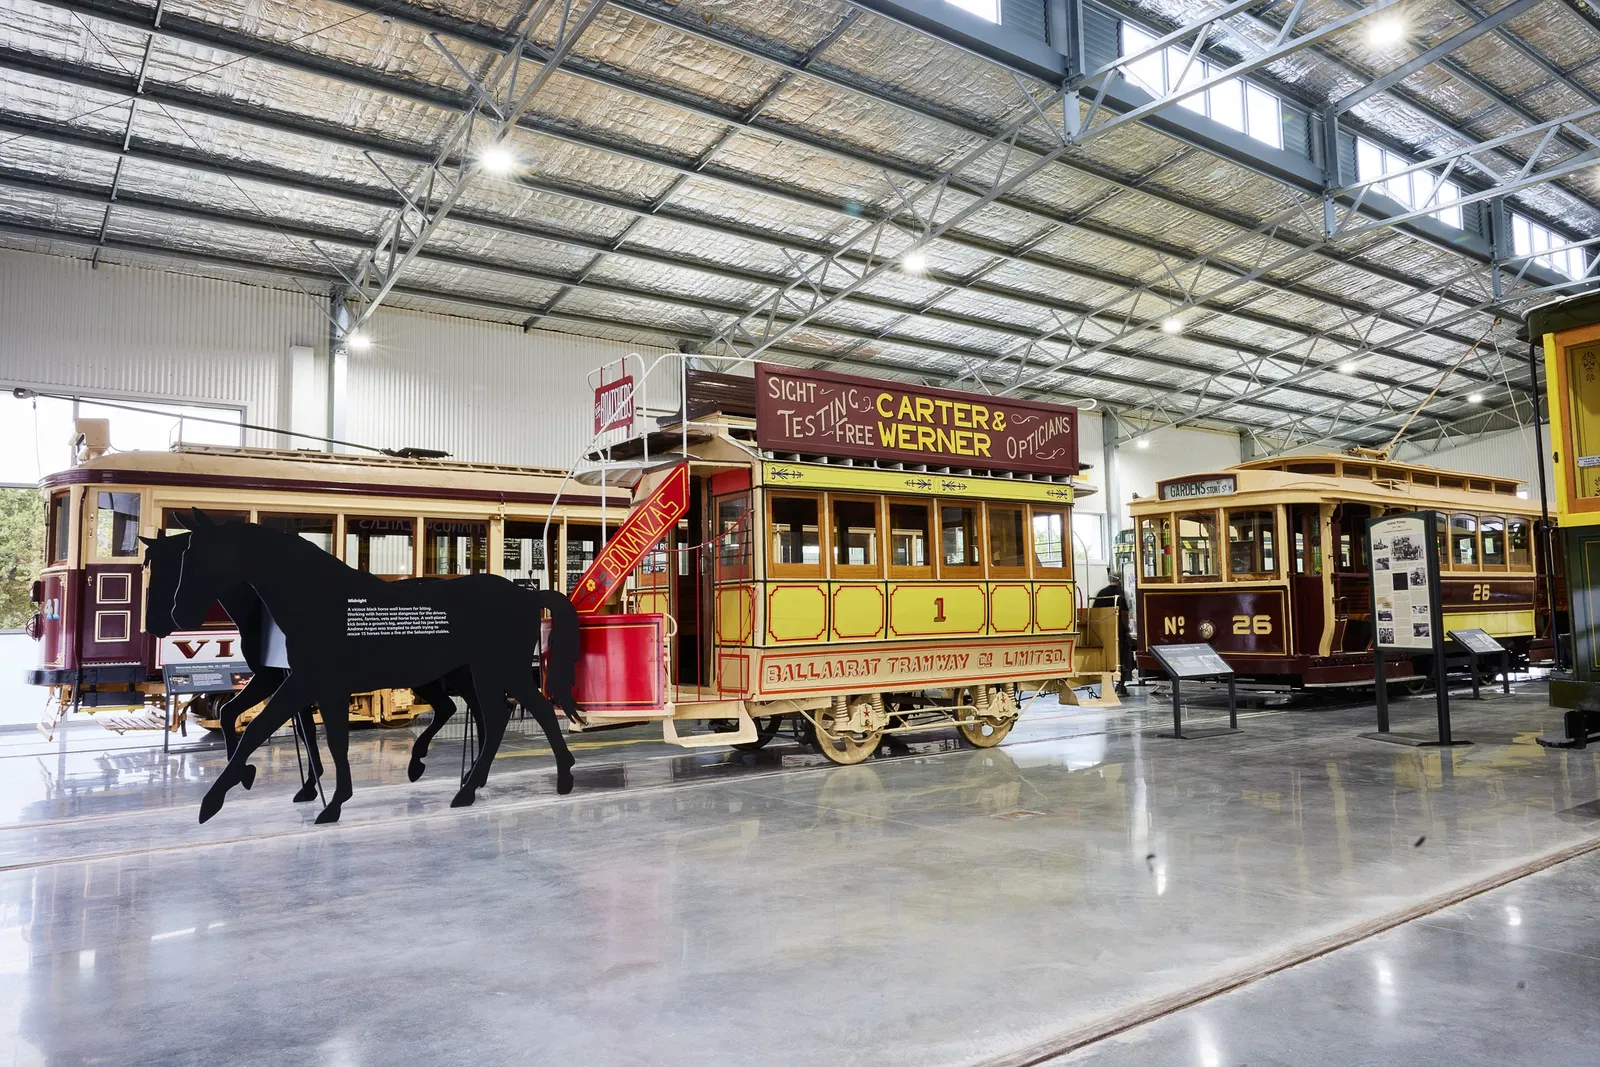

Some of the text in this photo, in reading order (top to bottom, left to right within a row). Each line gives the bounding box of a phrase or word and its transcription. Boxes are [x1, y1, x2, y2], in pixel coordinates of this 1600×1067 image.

[768, 376, 817, 403] SIGHT
[777, 388, 859, 438] TESTING
[876, 392, 1007, 432] CARTER &
[835, 417, 875, 446] FREE
[877, 421, 992, 457] WERNER
[1006, 416, 1070, 460] OPTICIANS
[1170, 482, 1206, 497] GARDENS
[600, 492, 679, 579] BONANZA'S
[1473, 584, 1490, 600] 26
[44, 598, 60, 620] 41
[933, 597, 946, 622] 1
[1232, 615, 1272, 635] 26
[766, 654, 882, 684] BALLAARAT
[887, 653, 971, 674] TRAMWAY
